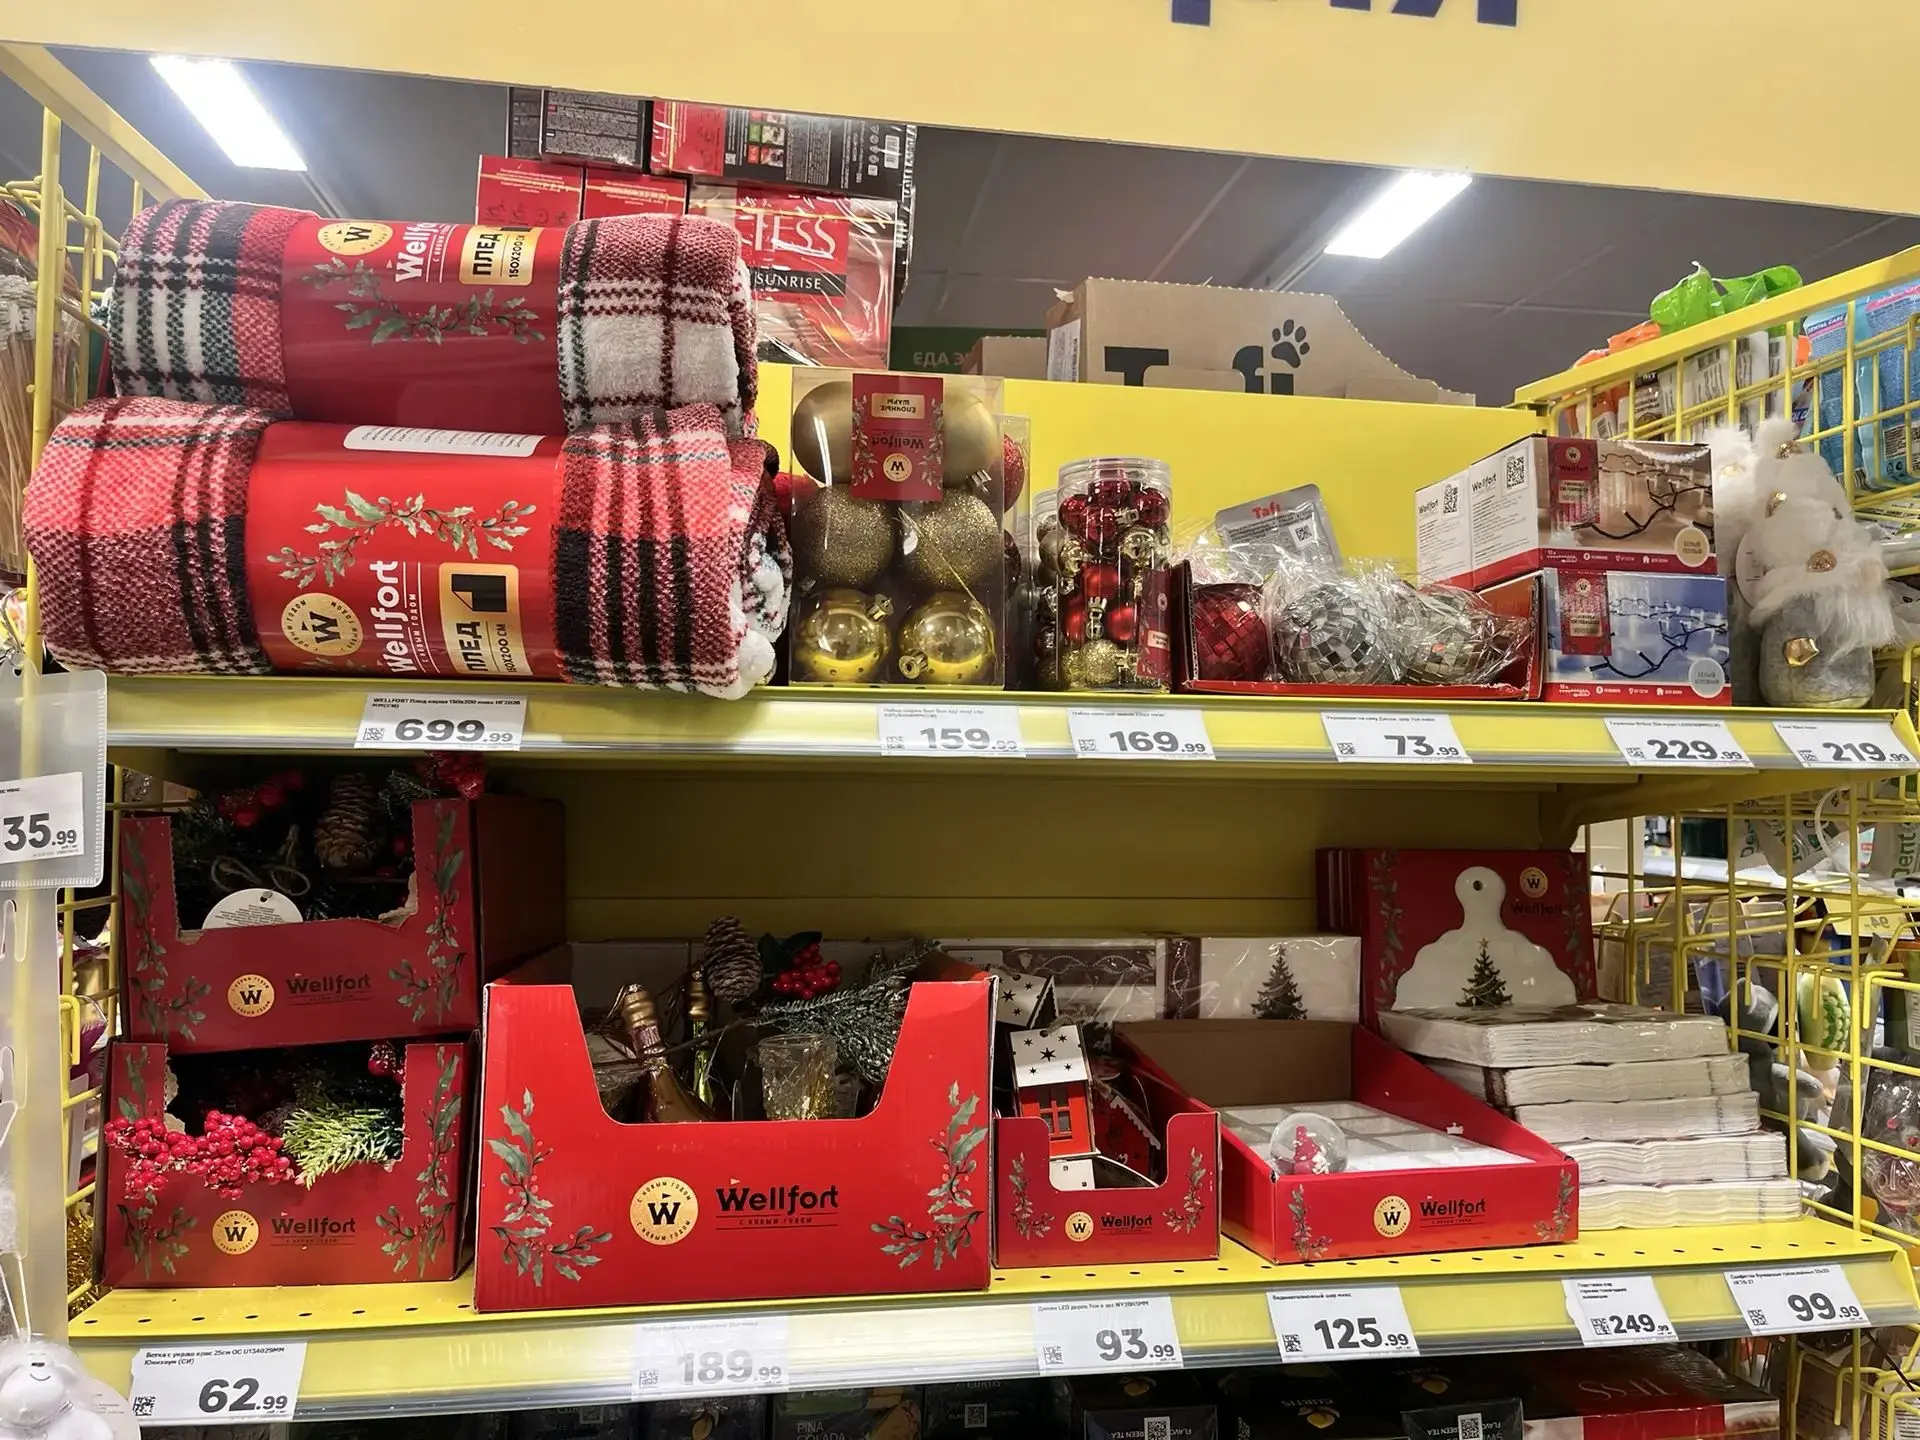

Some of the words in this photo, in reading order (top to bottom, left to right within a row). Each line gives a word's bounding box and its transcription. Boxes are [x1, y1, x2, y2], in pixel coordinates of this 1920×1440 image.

[344, 226, 373, 244] W
[472, 232, 502, 276] ПЛЕД
[755, 272, 822, 290] SUNRISE
[913, 352, 949, 368] ЕДА
[1104, 345, 1295, 396] Tfi
[871, 435, 925, 449] Wellfort
[1471, 473, 1497, 492] Wellfort
[369, 560, 418, 673] Wellfort
[309, 610, 342, 644] W
[498, 623, 507, 637] СМ
[456, 620, 490, 672] ПЛЕД
[395, 718, 513, 742] 699.99
[920, 727, 1018, 750] 159.99
[1109, 730, 1206, 752] 169.99
[1383, 734, 1460, 756] 73.99
[1647, 739, 1743, 760] 229.99
[1822, 742, 1910, 762] 219.99
[3, 812, 77, 852] 35.99
[286, 973, 371, 993] Wellfort
[239, 989, 262, 1006] W
[642, 1180, 667, 1197] НОВЫМ
[671, 1181, 692, 1201] ГОДОМ
[715, 1184, 839, 1215] Wellfort
[647, 1201, 682, 1226] W
[1419, 1198, 1487, 1217] Wellfort
[271, 1216, 356, 1236] Wellfort
[1072, 1222, 1087, 1233] W
[1100, 1215, 1153, 1229] Wellfort
[1384, 1210, 1402, 1226] W
[224, 1226, 248, 1242] W
[1787, 1292, 1860, 1322] 99.99
[1609, 1313, 1669, 1333] 249.99
[1314, 1317, 1409, 1350] 125.99
[1095, 1328, 1175, 1361] 93.99
[145, 1351, 166, 1359] Ветка
[677, 1349, 782, 1385] 189.99
[198, 1377, 288, 1413] 62.99
[797, 1421, 823, 1433] PINA
[1111, 1431, 1125, 1439] TEA
[1426, 1428, 1440, 1436] TEA
